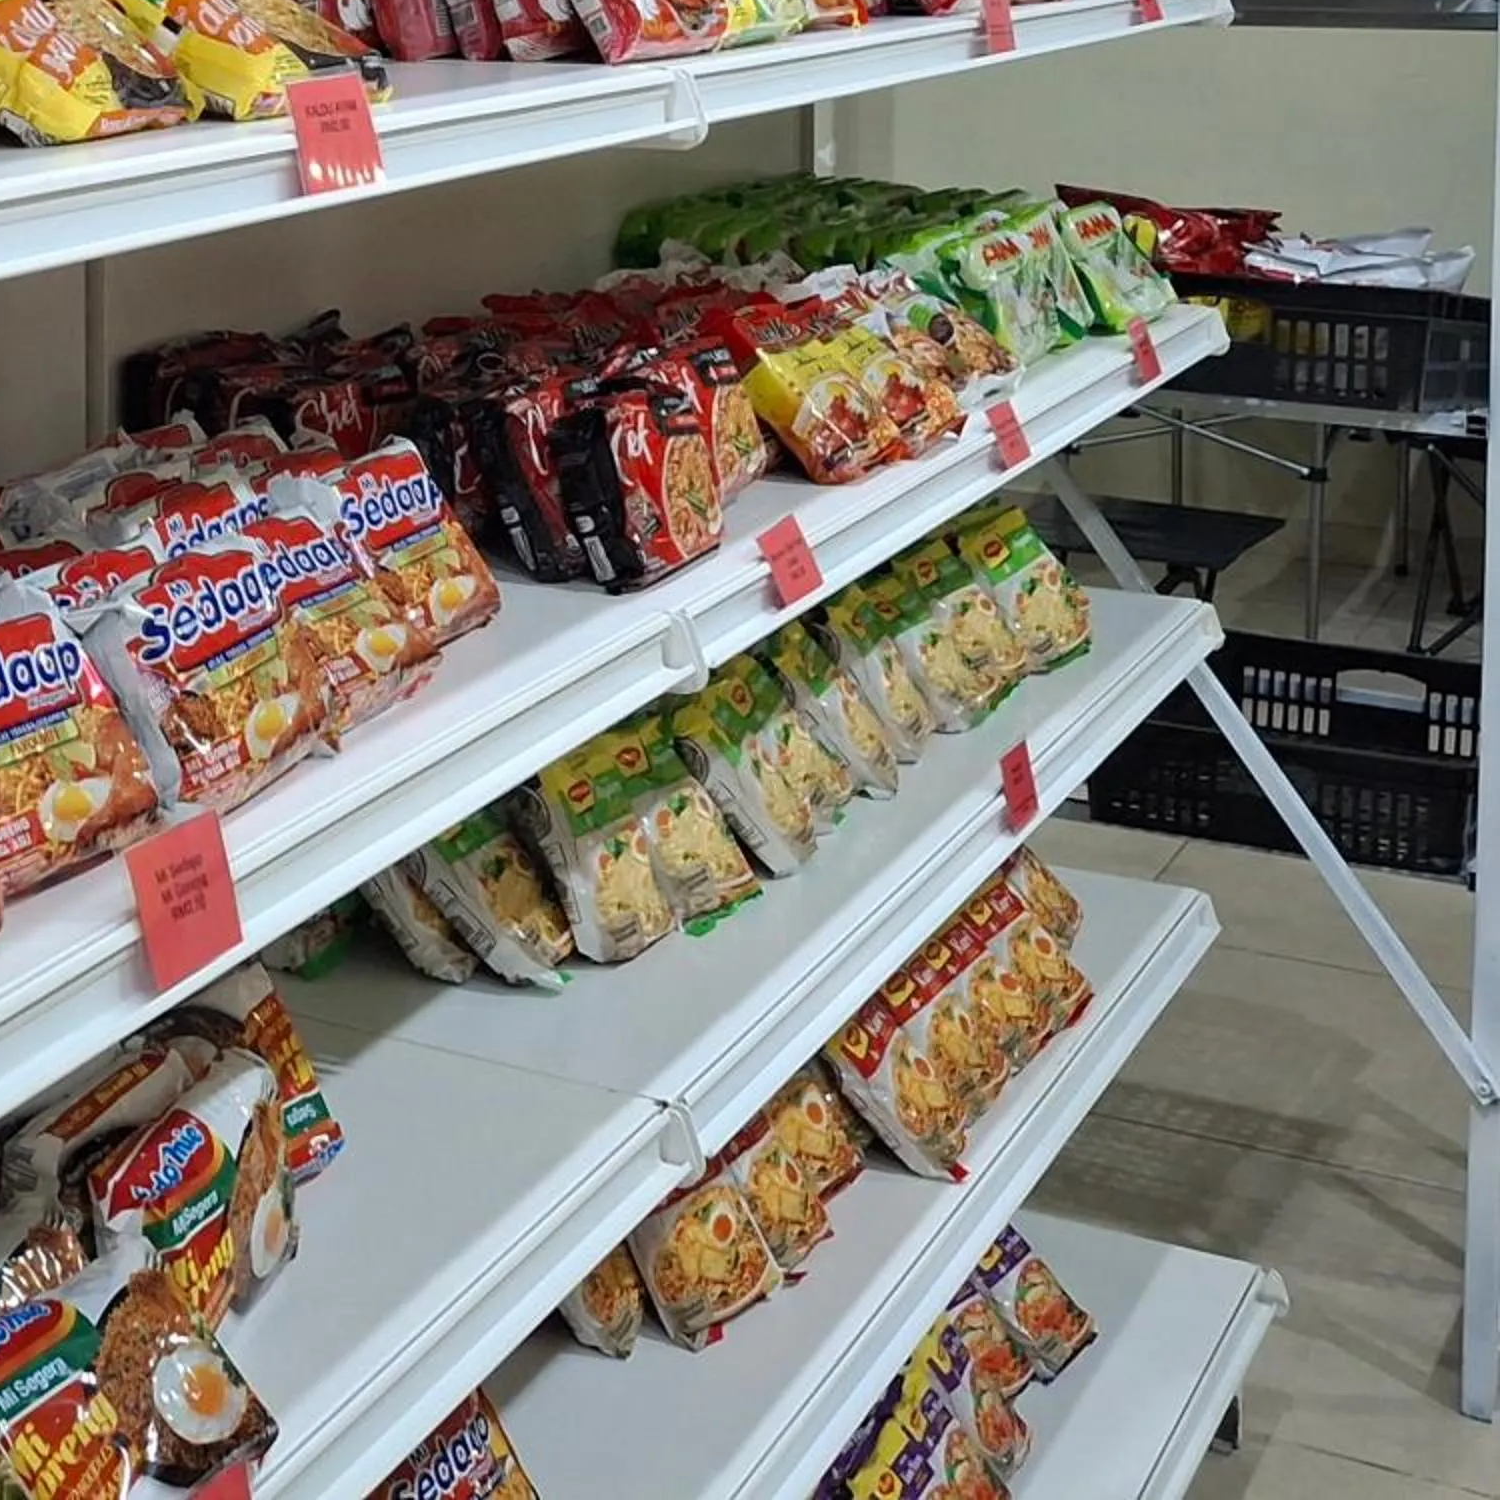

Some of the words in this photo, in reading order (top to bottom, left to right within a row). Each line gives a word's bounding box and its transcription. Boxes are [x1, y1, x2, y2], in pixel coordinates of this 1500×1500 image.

[340, 474, 443, 538] Sedaap
[167, 580, 192, 599] Mi
[15, 1357, 70, 1397] Segera
